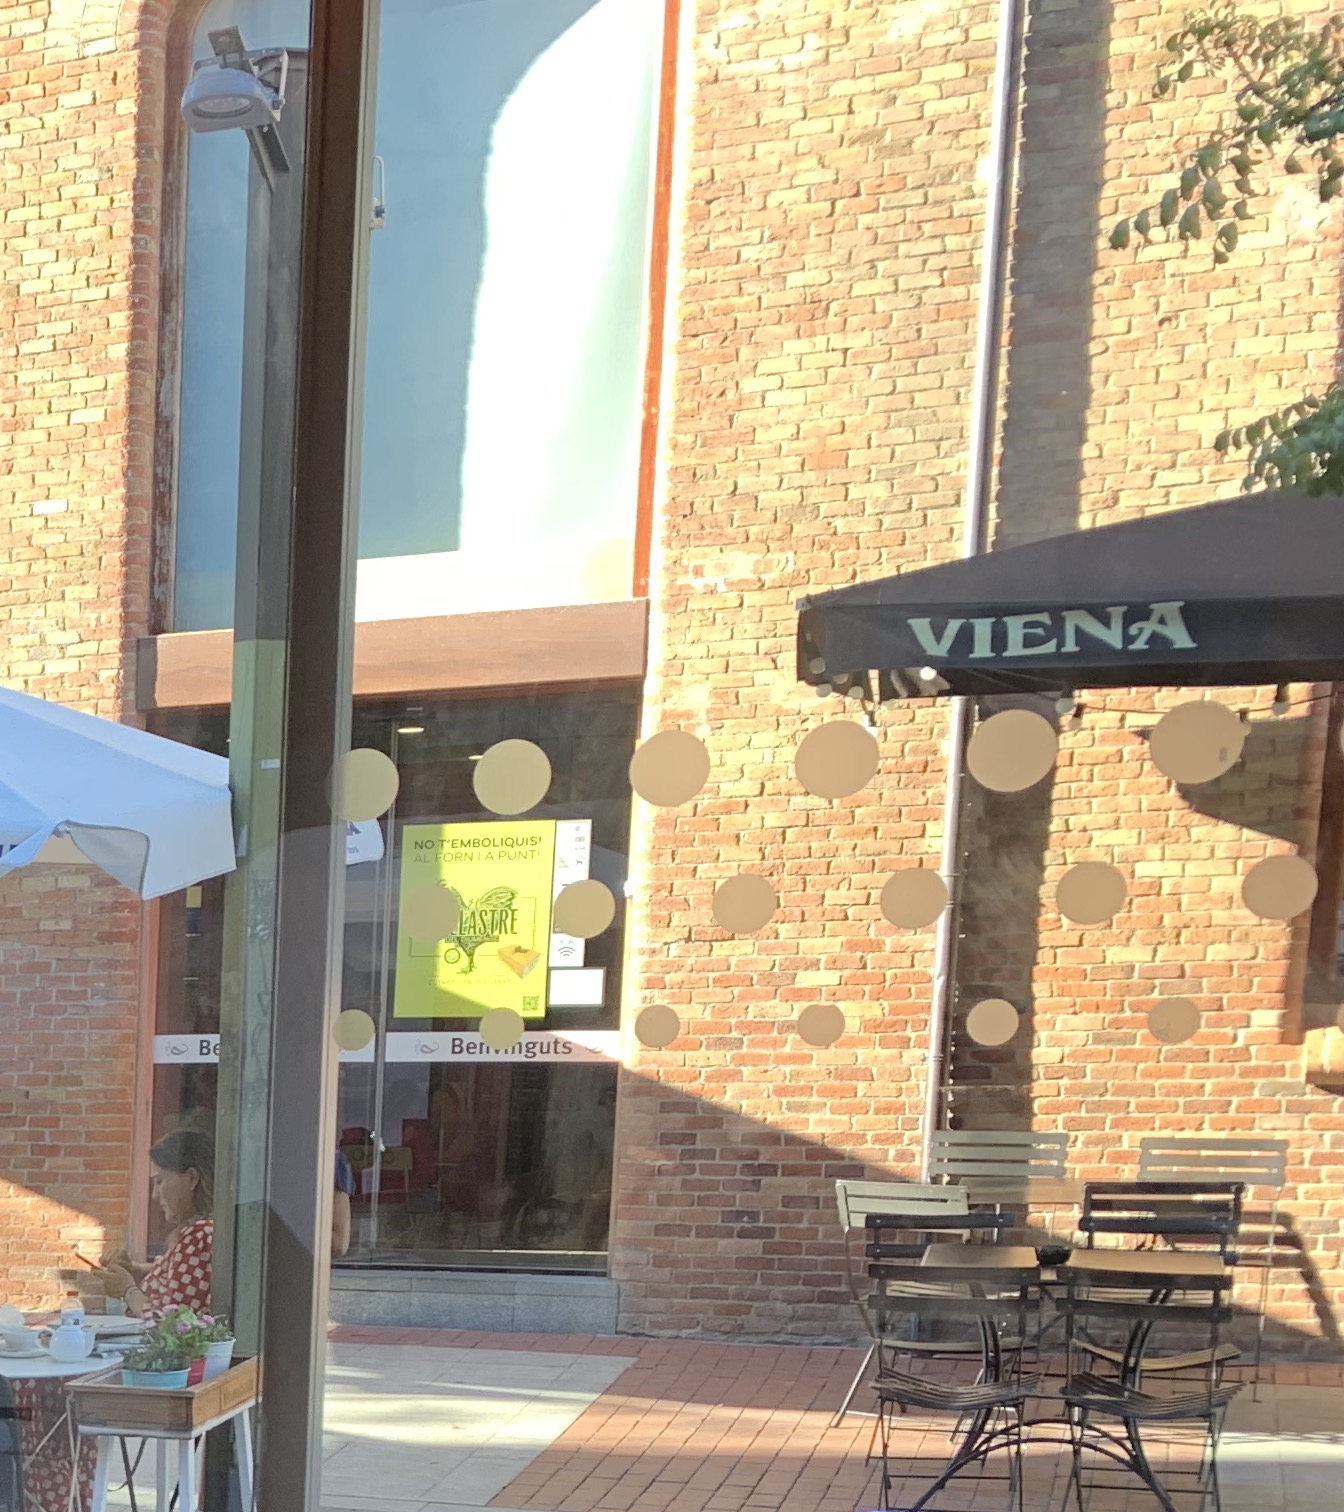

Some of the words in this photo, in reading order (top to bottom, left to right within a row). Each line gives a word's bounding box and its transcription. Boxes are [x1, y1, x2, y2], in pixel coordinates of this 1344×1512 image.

[906, 601, 1199, 660] VIENA
[414, 839, 436, 850] NO
[413, 852, 431, 864] AL
[435, 852, 474, 864] FORN
[485, 852, 494, 861] A
